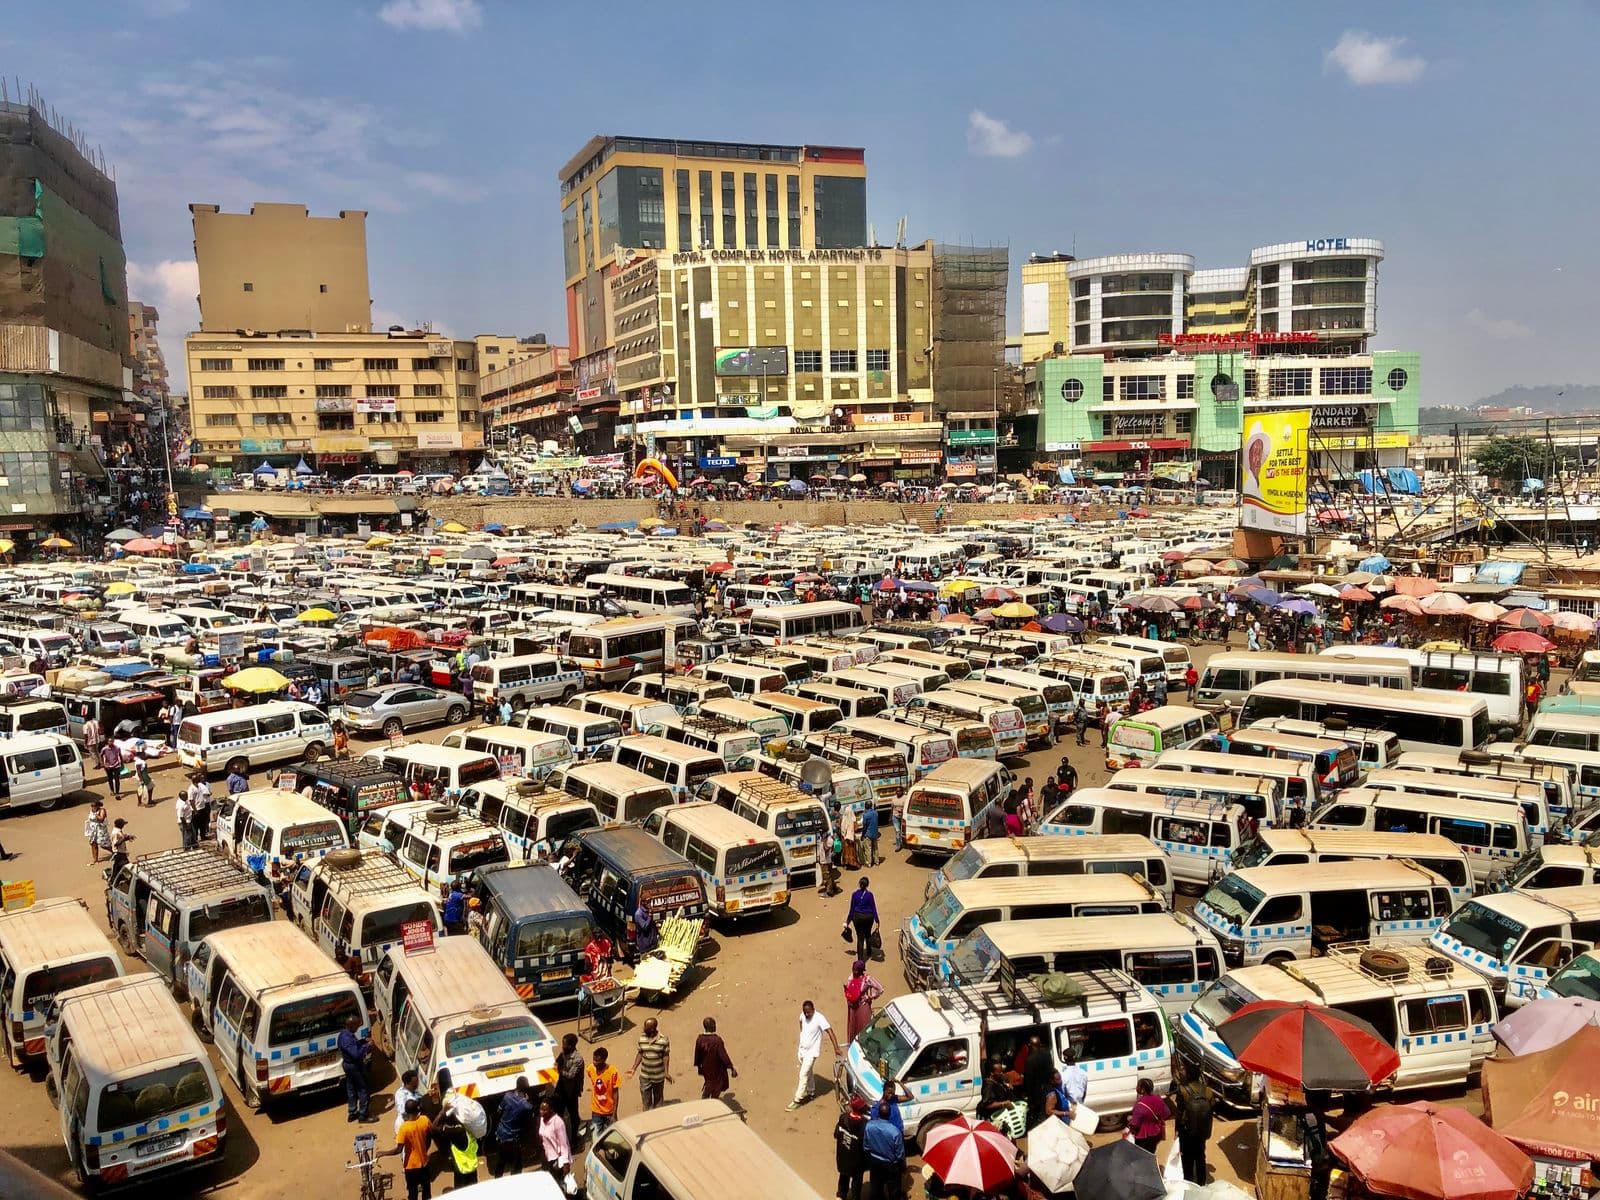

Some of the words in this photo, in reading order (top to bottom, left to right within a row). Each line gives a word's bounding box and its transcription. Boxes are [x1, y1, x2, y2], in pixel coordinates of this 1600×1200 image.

[1306, 238, 1351, 252] HOTEL
[672, 251, 706, 266] ROYAL
[711, 249, 765, 263] COMPLEX
[769, 249, 805, 261] HOTEL
[1245, 332, 1319, 343] BUILDING
[1312, 407, 1358, 416] ANDARD
[893, 413, 911, 422] BET
[1311, 416, 1353, 427] MARKET
[790, 426, 814, 434] ROYAL
[821, 425, 856, 434] COMPLEX
[320, 453, 358, 463] Bata
[1498, 917, 1522, 932] JESUS
